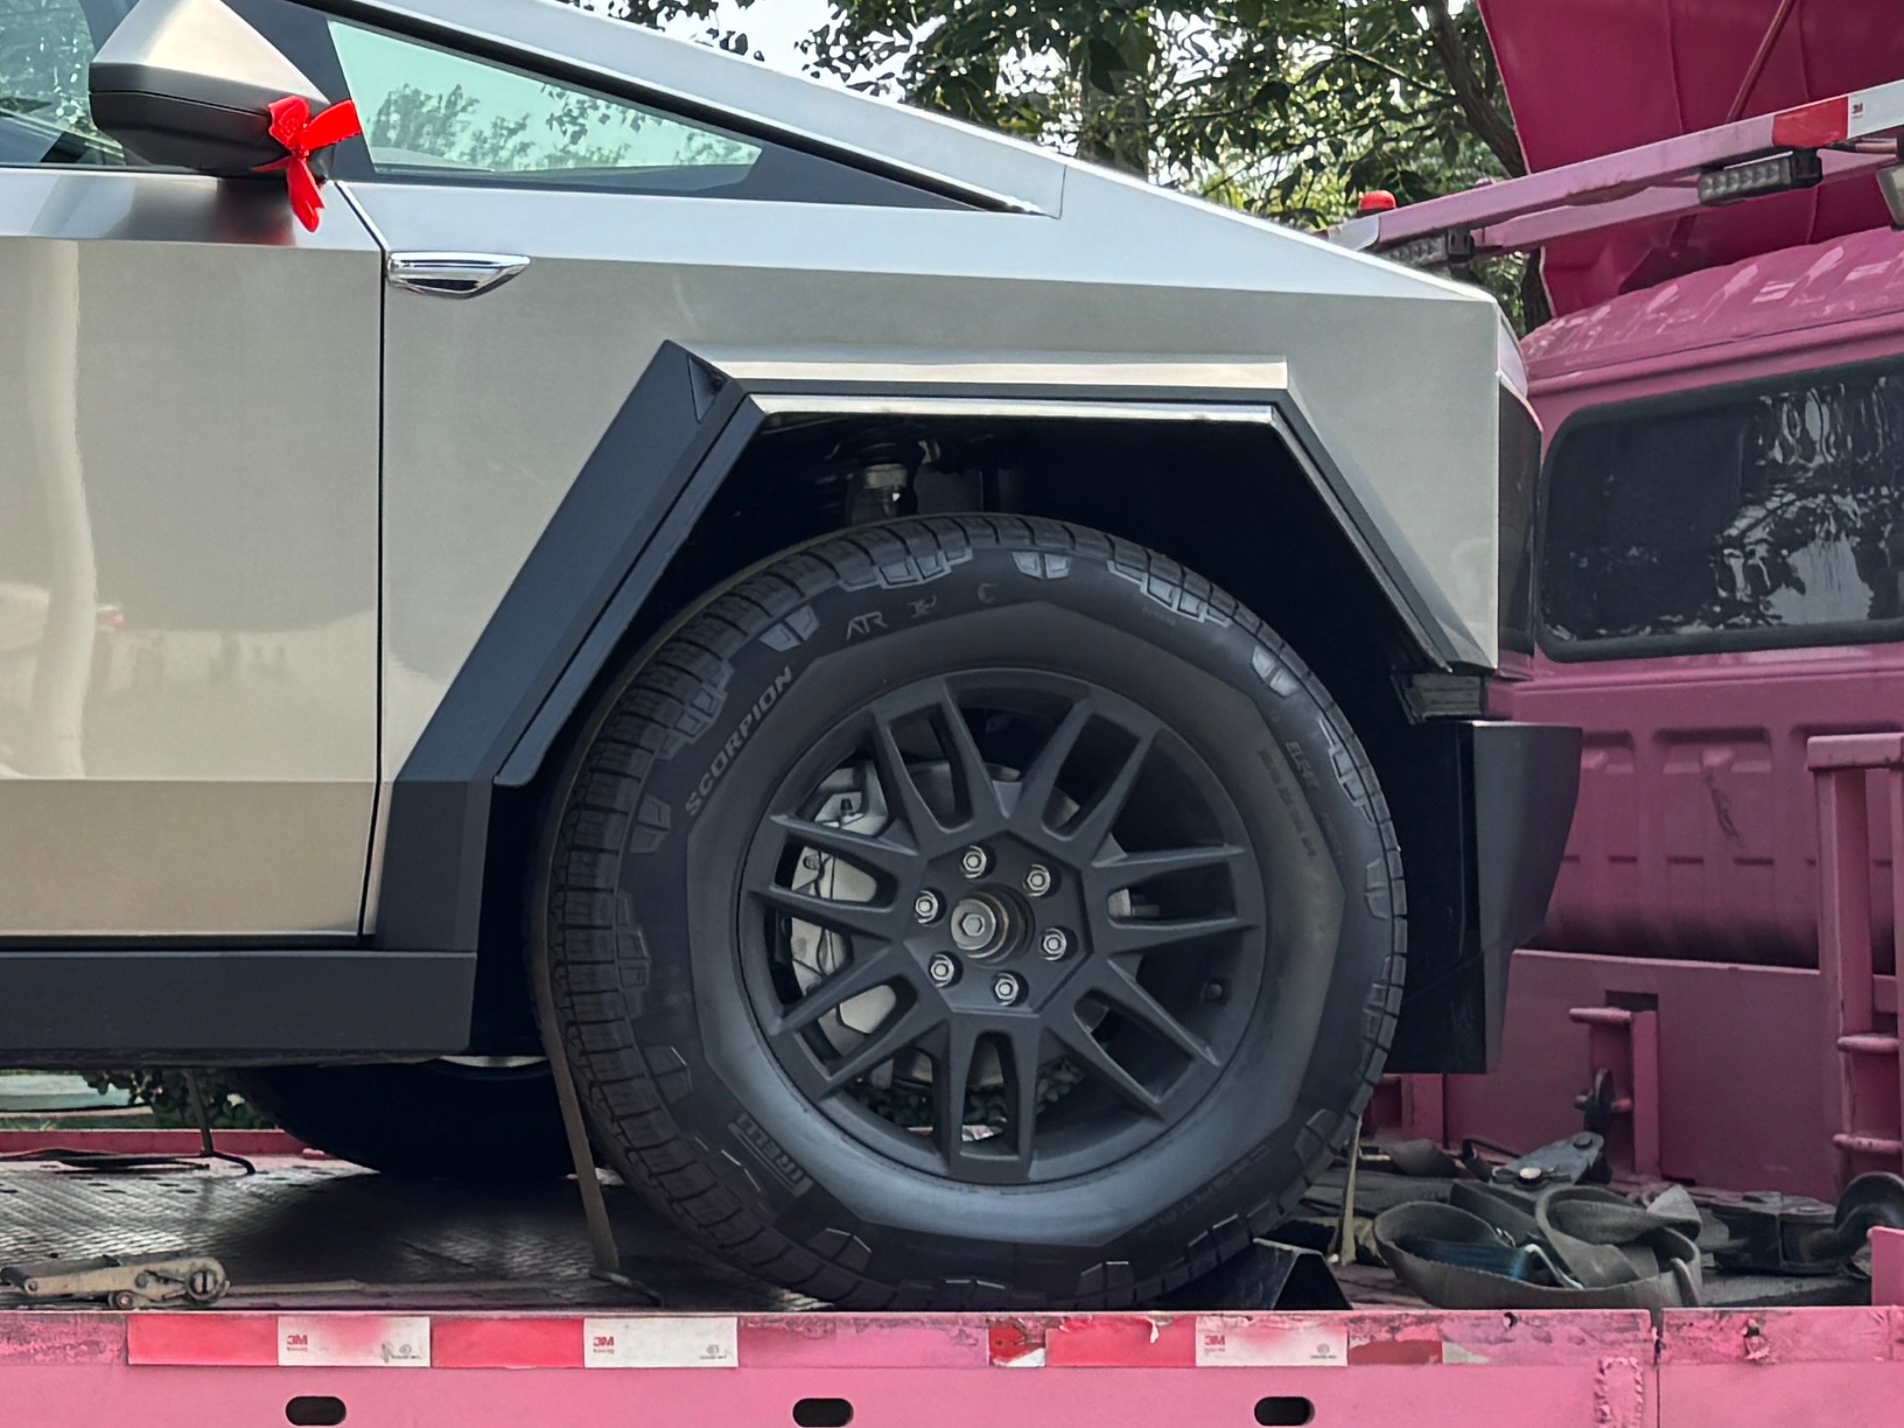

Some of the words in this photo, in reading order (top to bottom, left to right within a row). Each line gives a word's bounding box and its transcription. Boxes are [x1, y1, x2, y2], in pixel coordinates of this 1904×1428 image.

[685, 665, 795, 817] SCORPION
[845, 610, 889, 640] ATR
[728, 1114, 811, 1196] PIRELLI
[287, 1335, 308, 1346] 3M
[593, 1336, 614, 1347] 3M
[1205, 1335, 1225, 1346] 3M
